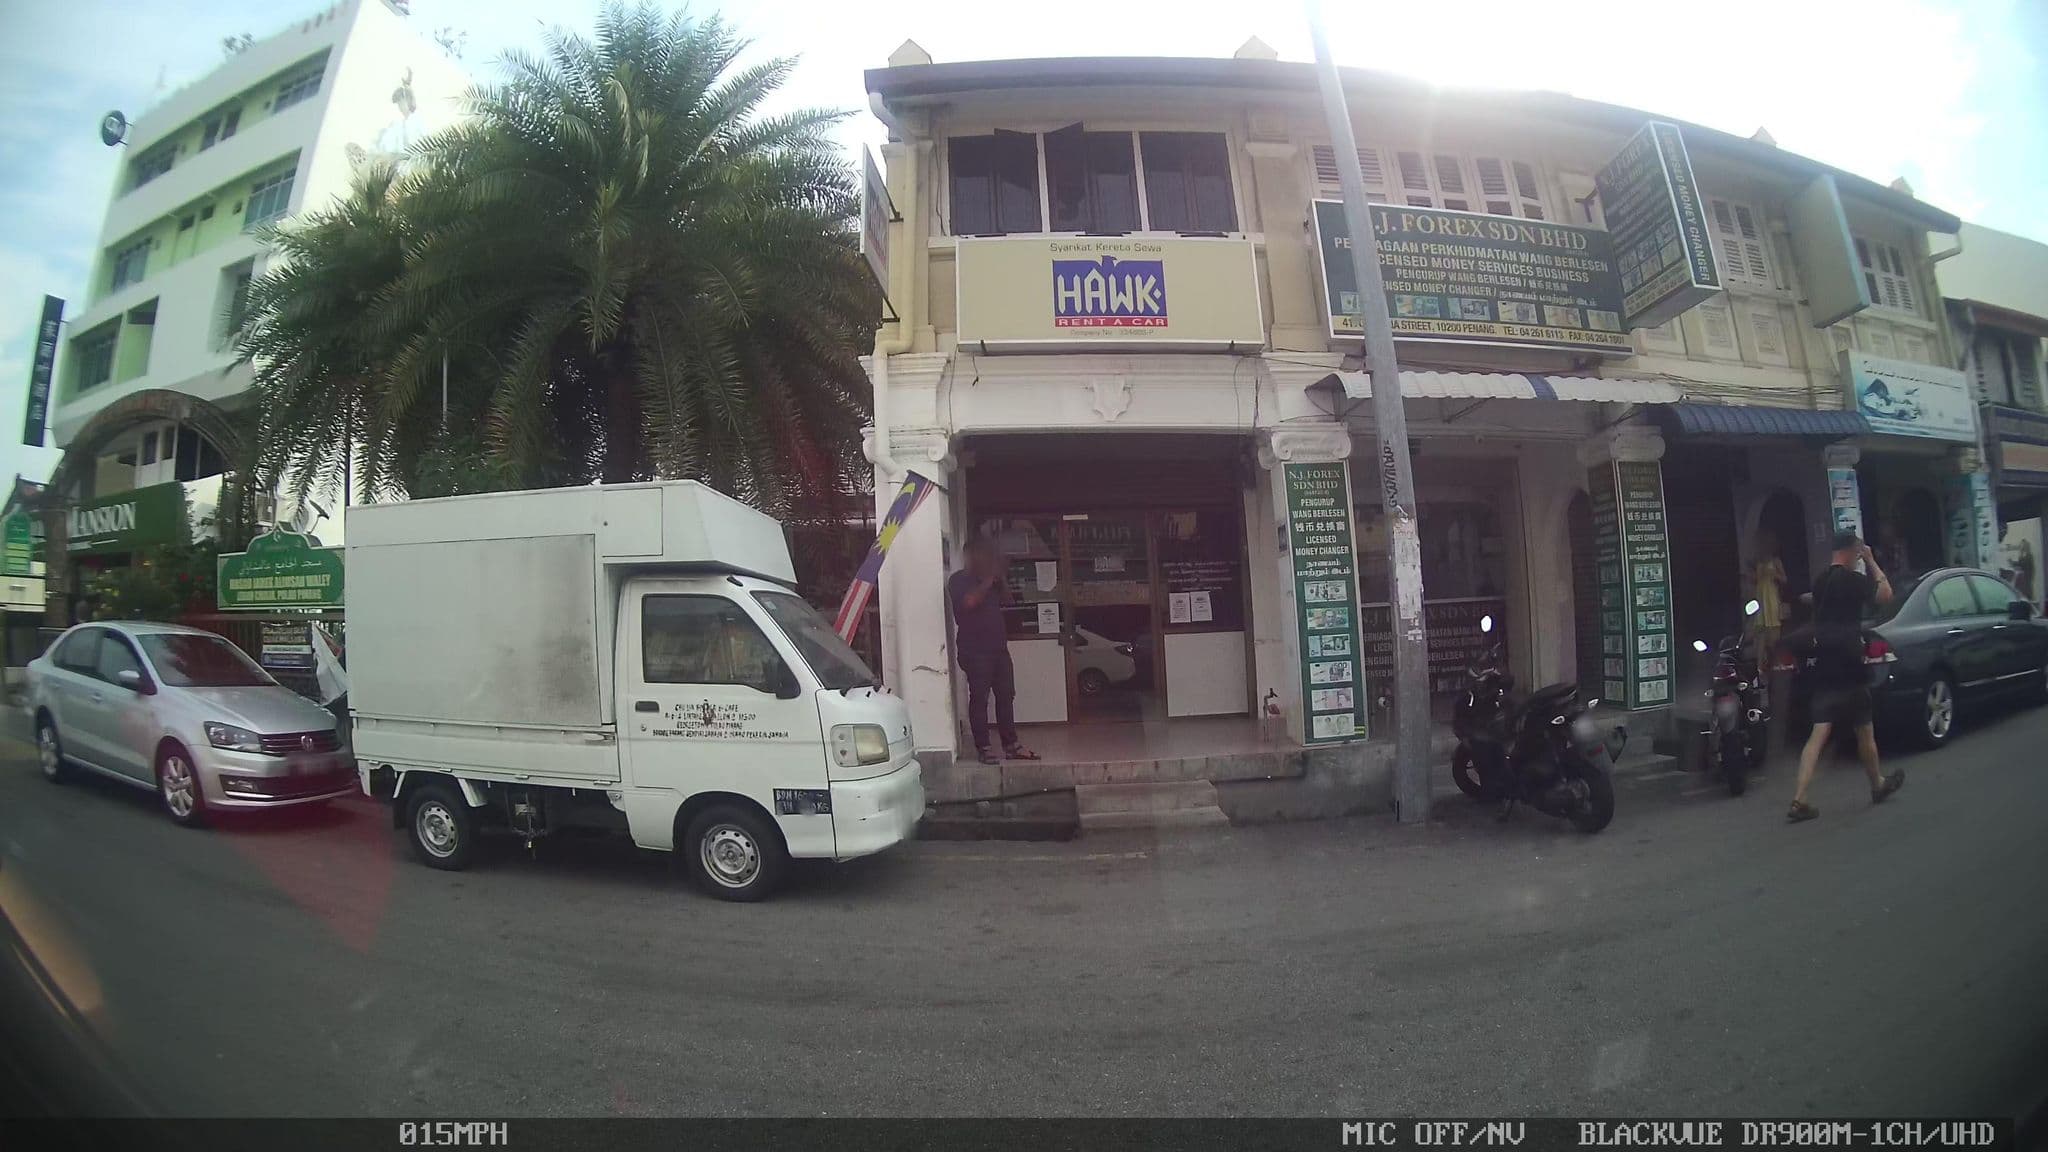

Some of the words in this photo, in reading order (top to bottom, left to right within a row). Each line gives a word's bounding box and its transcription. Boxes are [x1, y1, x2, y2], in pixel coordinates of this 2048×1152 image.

[1401, 213, 1487, 239] FOREX
[1488, 221, 1536, 244] SDN
[1537, 228, 1587, 250] BHD
[1679, 184, 1697, 225] MONEY
[1688, 226, 1711, 282] CHANGER
[1050, 243, 1091, 253] Syarikat
[1095, 243, 1131, 252] Kereta
[1134, 243, 1162, 252] Sewa
[1422, 243, 1518, 262] PERKHIDMATAN
[1519, 251, 1553, 265] WANG
[1555, 256, 1608, 272] BERLESEN
[1431, 257, 1475, 270] MONEY
[1478, 260, 1534, 277] SERVICES
[1536, 267, 1590, 283] BUSINESS
[1396, 268, 1447, 281] PENGURUP
[1449, 272, 1476, 283] WANG
[1477, 273, 1521, 287] BERLESEN
[1056, 267, 1162, 315] HAWK
[1413, 282, 1447, 294] MONEY
[1450, 285, 1491, 297] CHANGER
[1058, 318, 1106, 326] RENT
[1113, 318, 1123, 326] A
[1132, 318, 1165, 326] CAR
[1437, 320, 1462, 333] 10200
[1307, 470, 1341, 479] FOREX
[1293, 481, 1315, 490] SDN
[1316, 480, 1338, 489] BHD
[1300, 498, 1335, 507] PENGURUP
[1292, 510, 1312, 519] WANG
[1312, 508, 1346, 518] BERLESEN
[1305, 535, 1337, 544] LICENSED
[1295, 547, 1318, 556] MONEY
[1319, 545, 1350, 555] CHANGER
